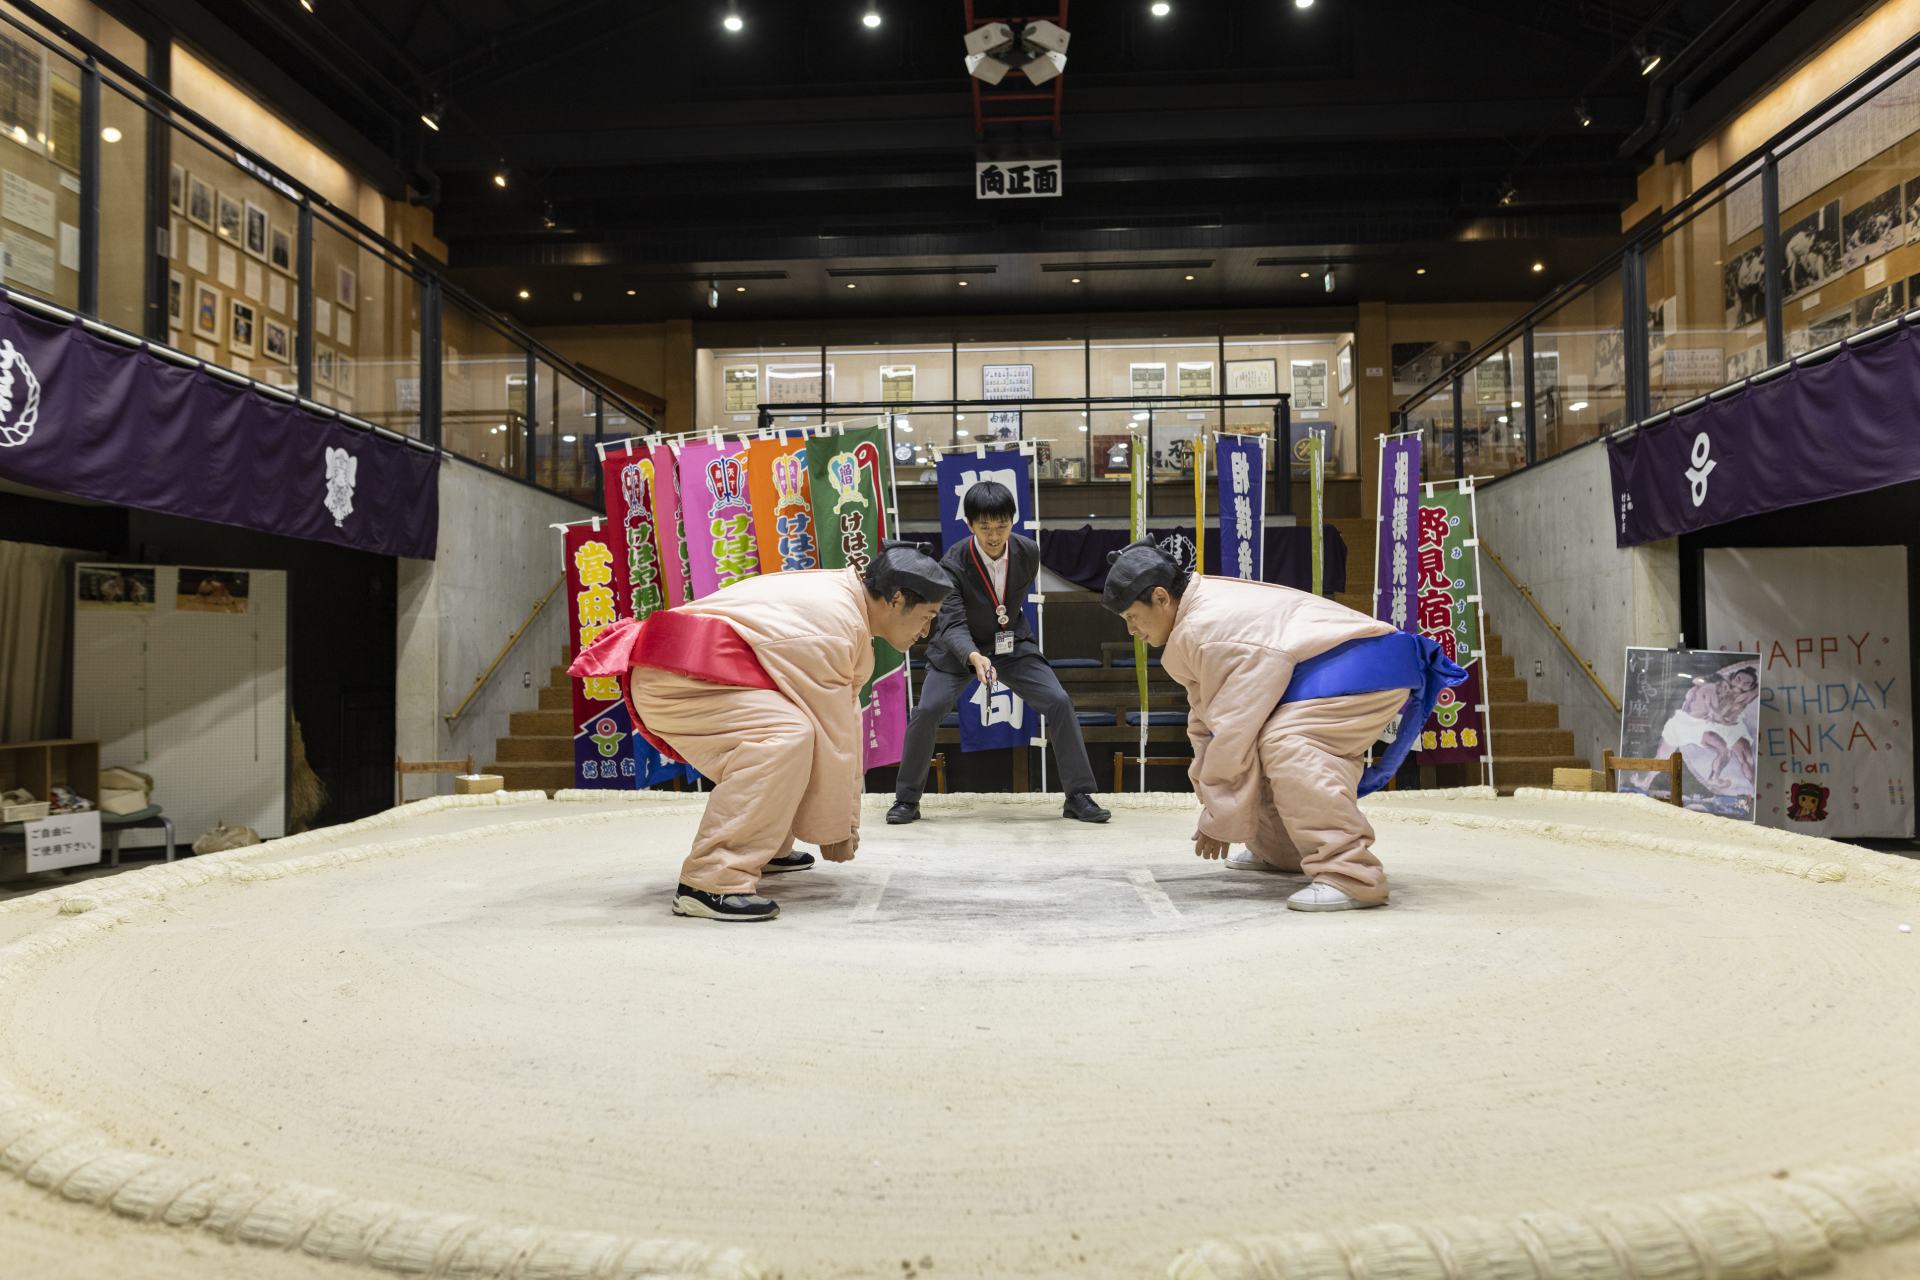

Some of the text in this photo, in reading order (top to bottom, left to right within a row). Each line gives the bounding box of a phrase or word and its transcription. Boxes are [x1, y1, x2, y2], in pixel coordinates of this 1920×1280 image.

[980, 164, 1058, 196] 向正面
[841, 512, 872, 578] けはや
[1449, 516, 1469, 653] のみのすくね
[1760, 677, 1896, 716] RTHDAY
[1758, 720, 1878, 757] ENKA
[1780, 757, 1830, 774] chan
[32, 827, 72, 839] ご自由に
